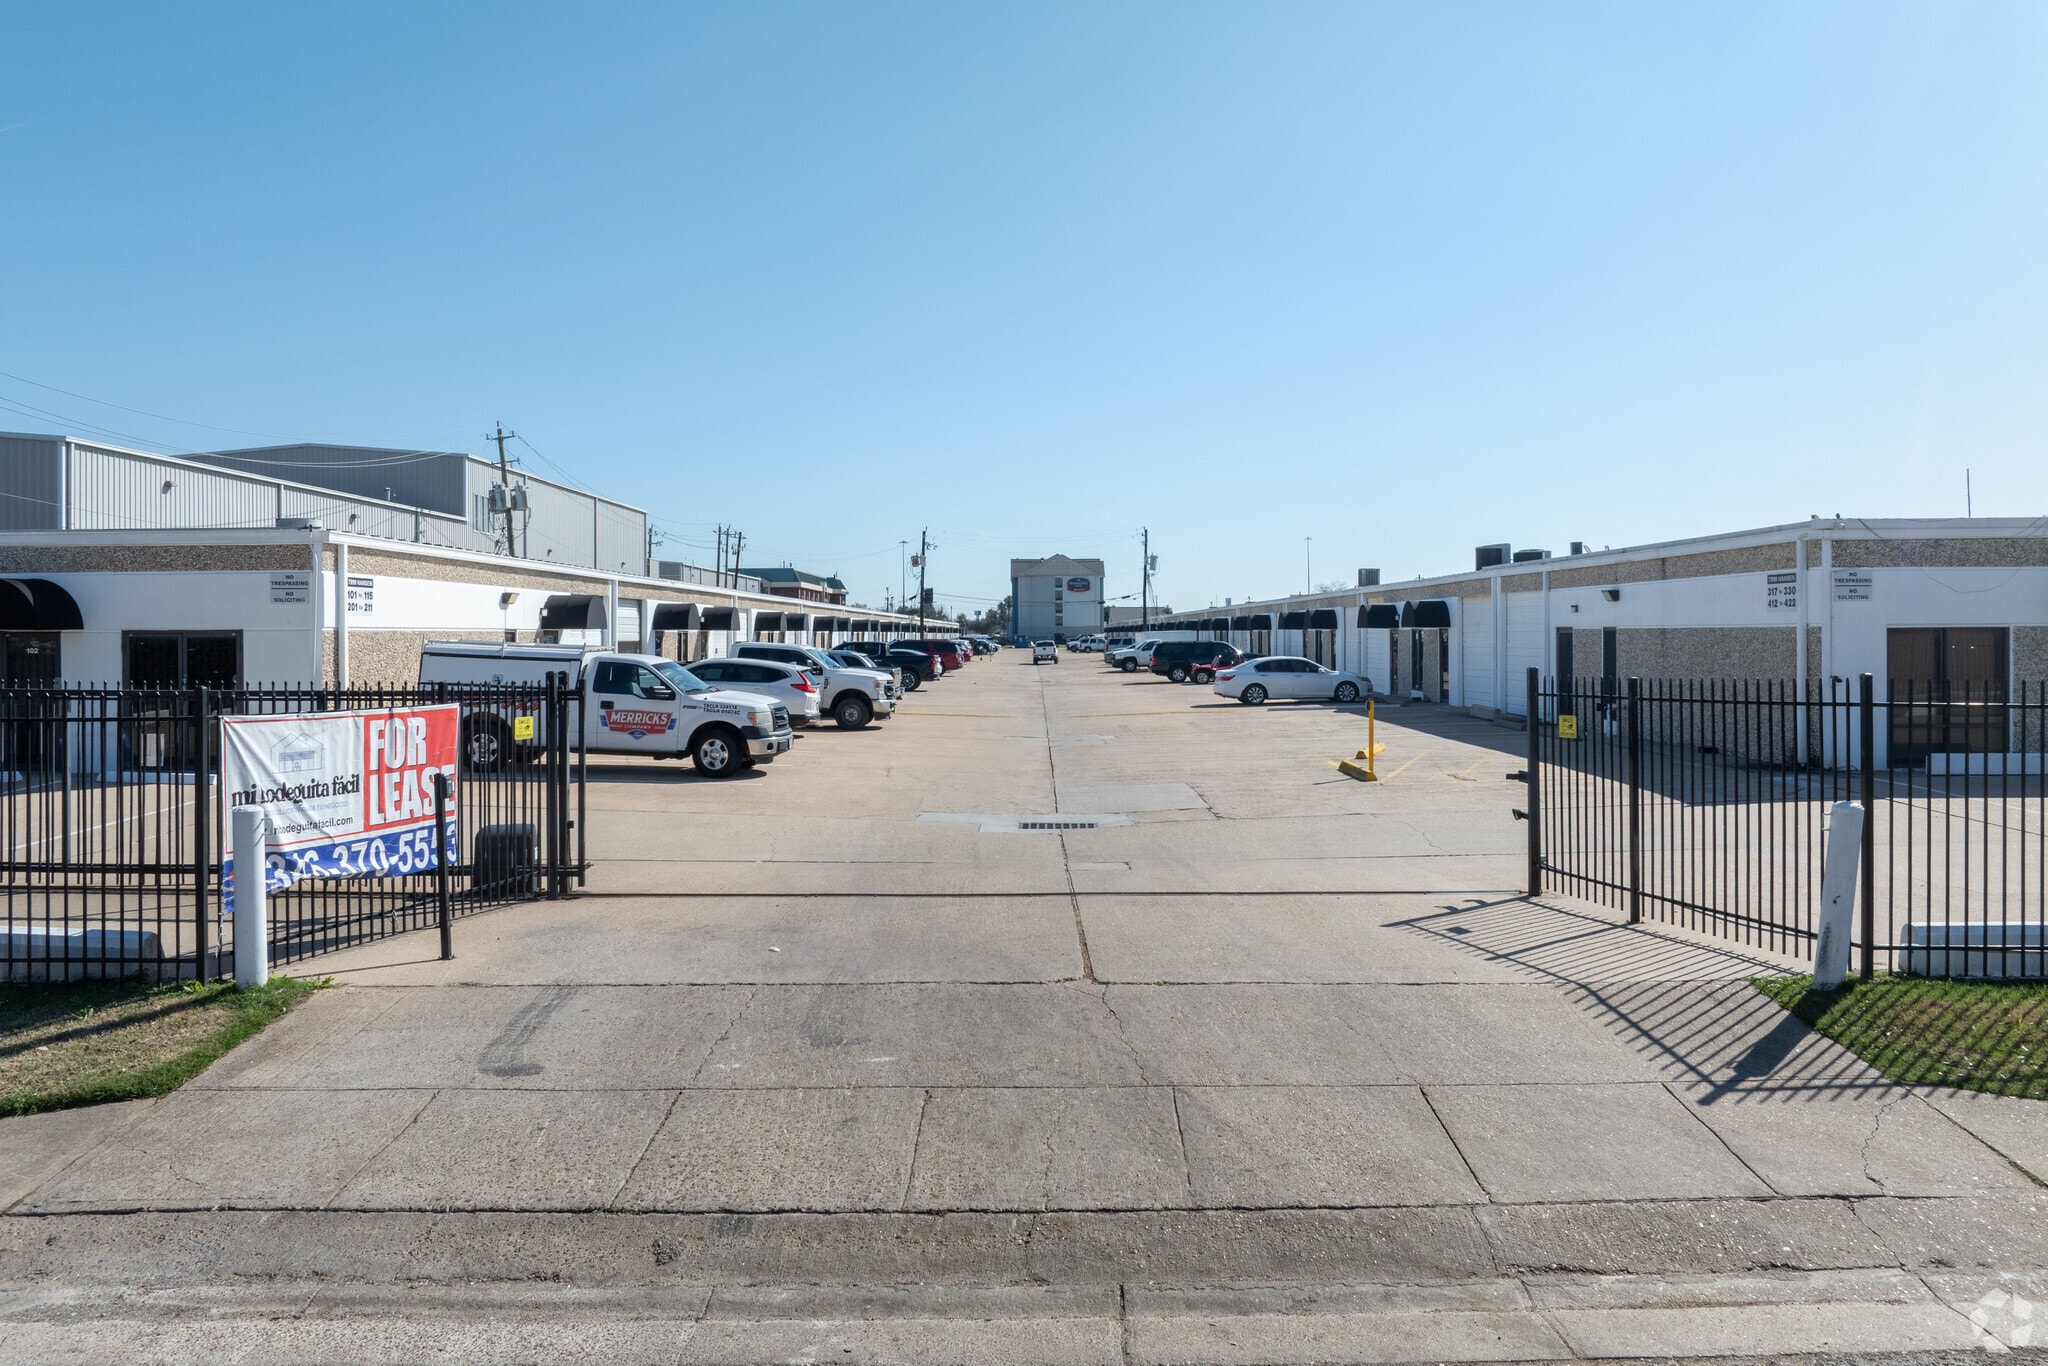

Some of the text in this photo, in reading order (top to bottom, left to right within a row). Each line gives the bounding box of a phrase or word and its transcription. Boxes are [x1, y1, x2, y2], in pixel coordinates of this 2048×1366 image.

[348, 591, 358, 599] 101
[364, 592, 373, 600] 115
[1768, 587, 1778, 596] 317
[1784, 586, 1796, 595] 330
[348, 603, 358, 611] 201
[364, 604, 373, 612] 211
[1768, 599, 1778, 608] 412
[1784, 598, 1796, 607] 422
[610, 711, 668, 725] MERRICKS
[369, 716, 427, 771] FOR
[231, 783, 257, 807] mi
[331, 773, 360, 796] fácil
[369, 764, 456, 826] LEASE
